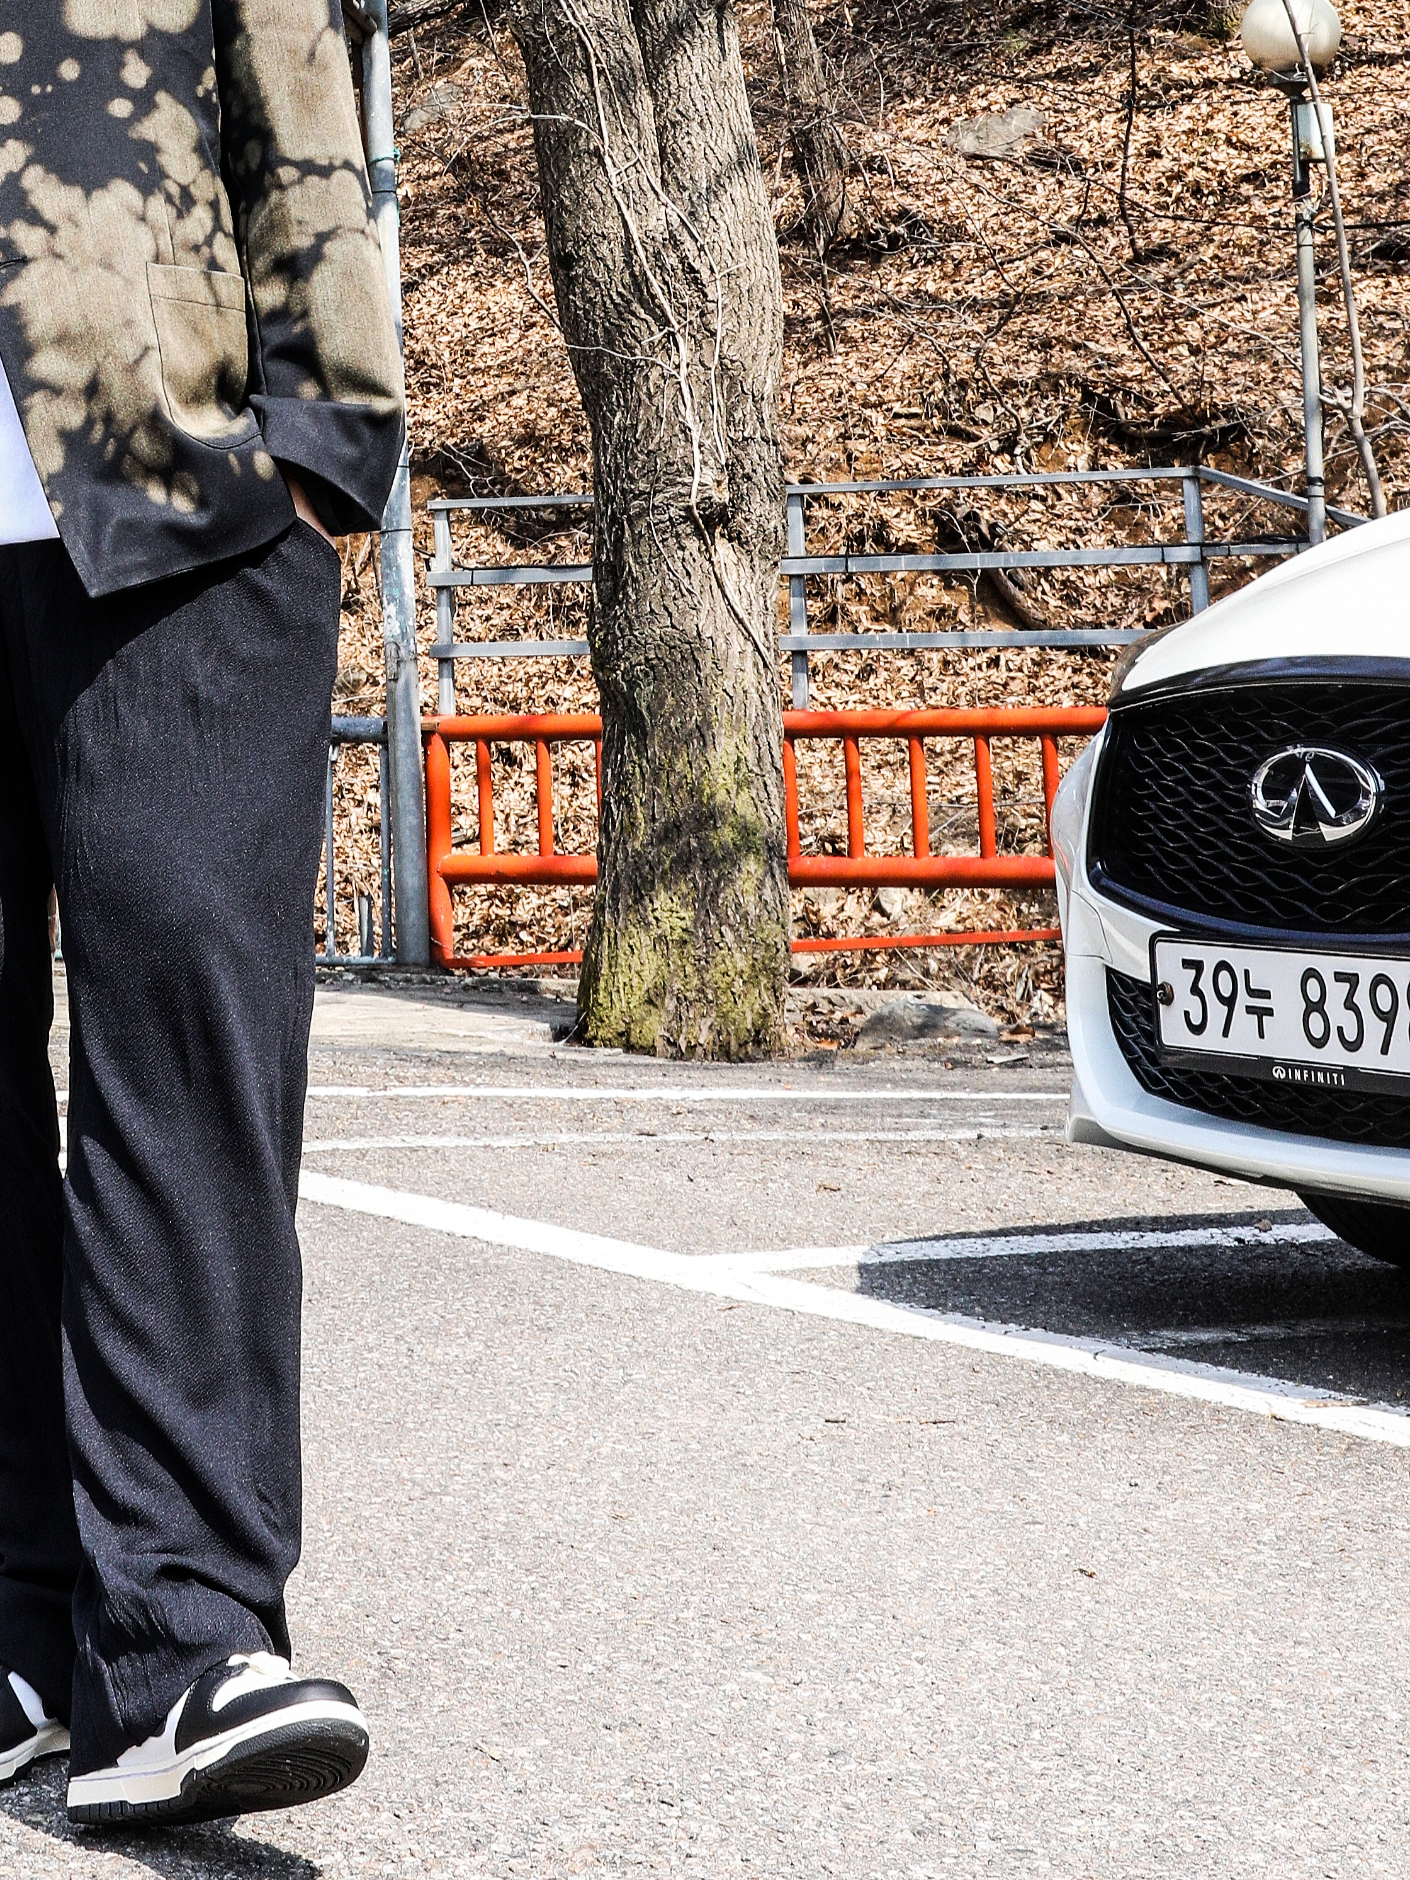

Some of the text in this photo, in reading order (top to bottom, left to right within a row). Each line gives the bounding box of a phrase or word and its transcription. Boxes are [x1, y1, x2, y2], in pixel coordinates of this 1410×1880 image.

[1181, 957, 1410, 1056] 39누 839
[1288, 1067, 1346, 1086] INFINITI
